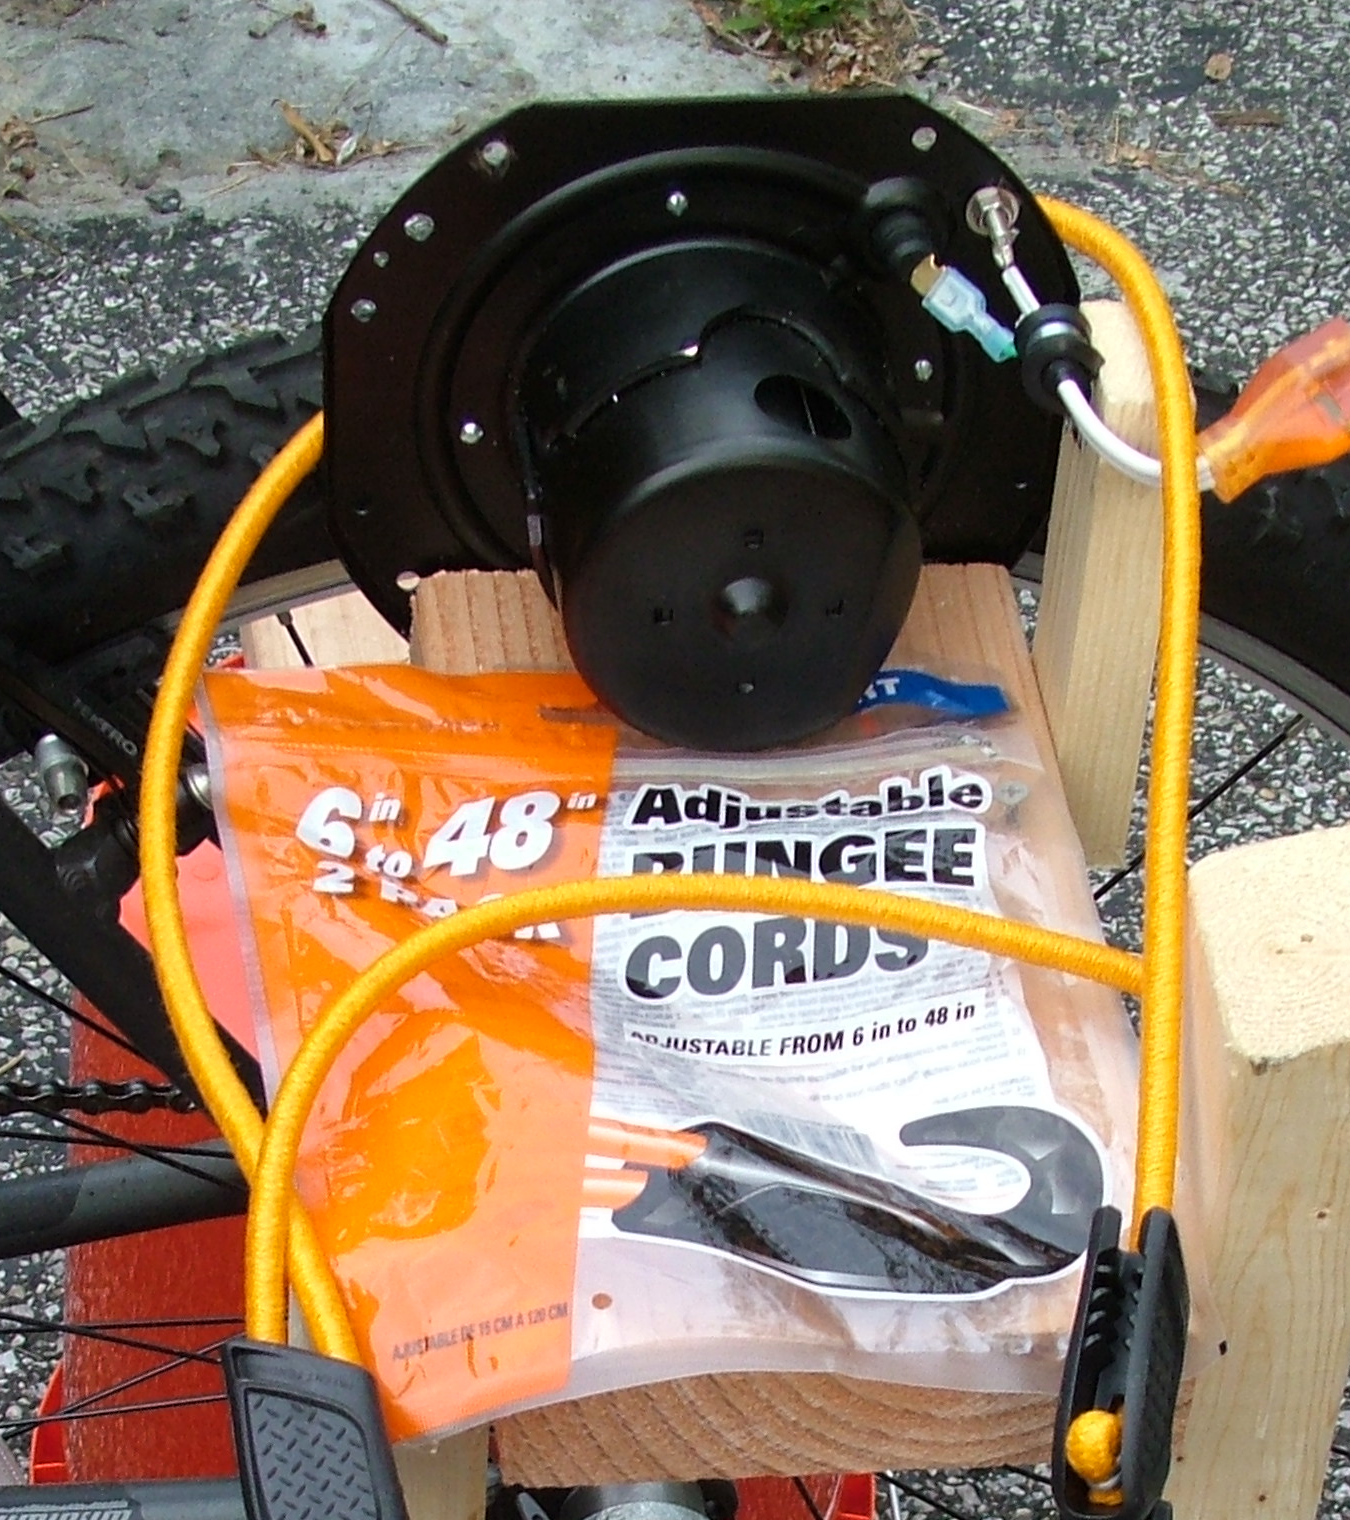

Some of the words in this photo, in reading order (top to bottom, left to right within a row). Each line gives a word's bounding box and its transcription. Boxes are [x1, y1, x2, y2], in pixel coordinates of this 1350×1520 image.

[296, 786, 362, 858] 6
[369, 793, 401, 822] in
[567, 792, 597, 810] in
[629, 770, 987, 830] Adjustable
[365, 844, 412, 878] to
[422, 790, 561, 876] 48
[312, 861, 355, 893] 2
[380, 878, 561, 939] PA
[625, 916, 930, 998] CORDS
[779, 1031, 844, 1056] FROM
[852, 1027, 864, 1046] 6
[871, 1021, 890, 1042] in
[898, 1017, 917, 1034] to
[925, 1006, 949, 1027] 48
[956, 1002, 976, 1021] in
